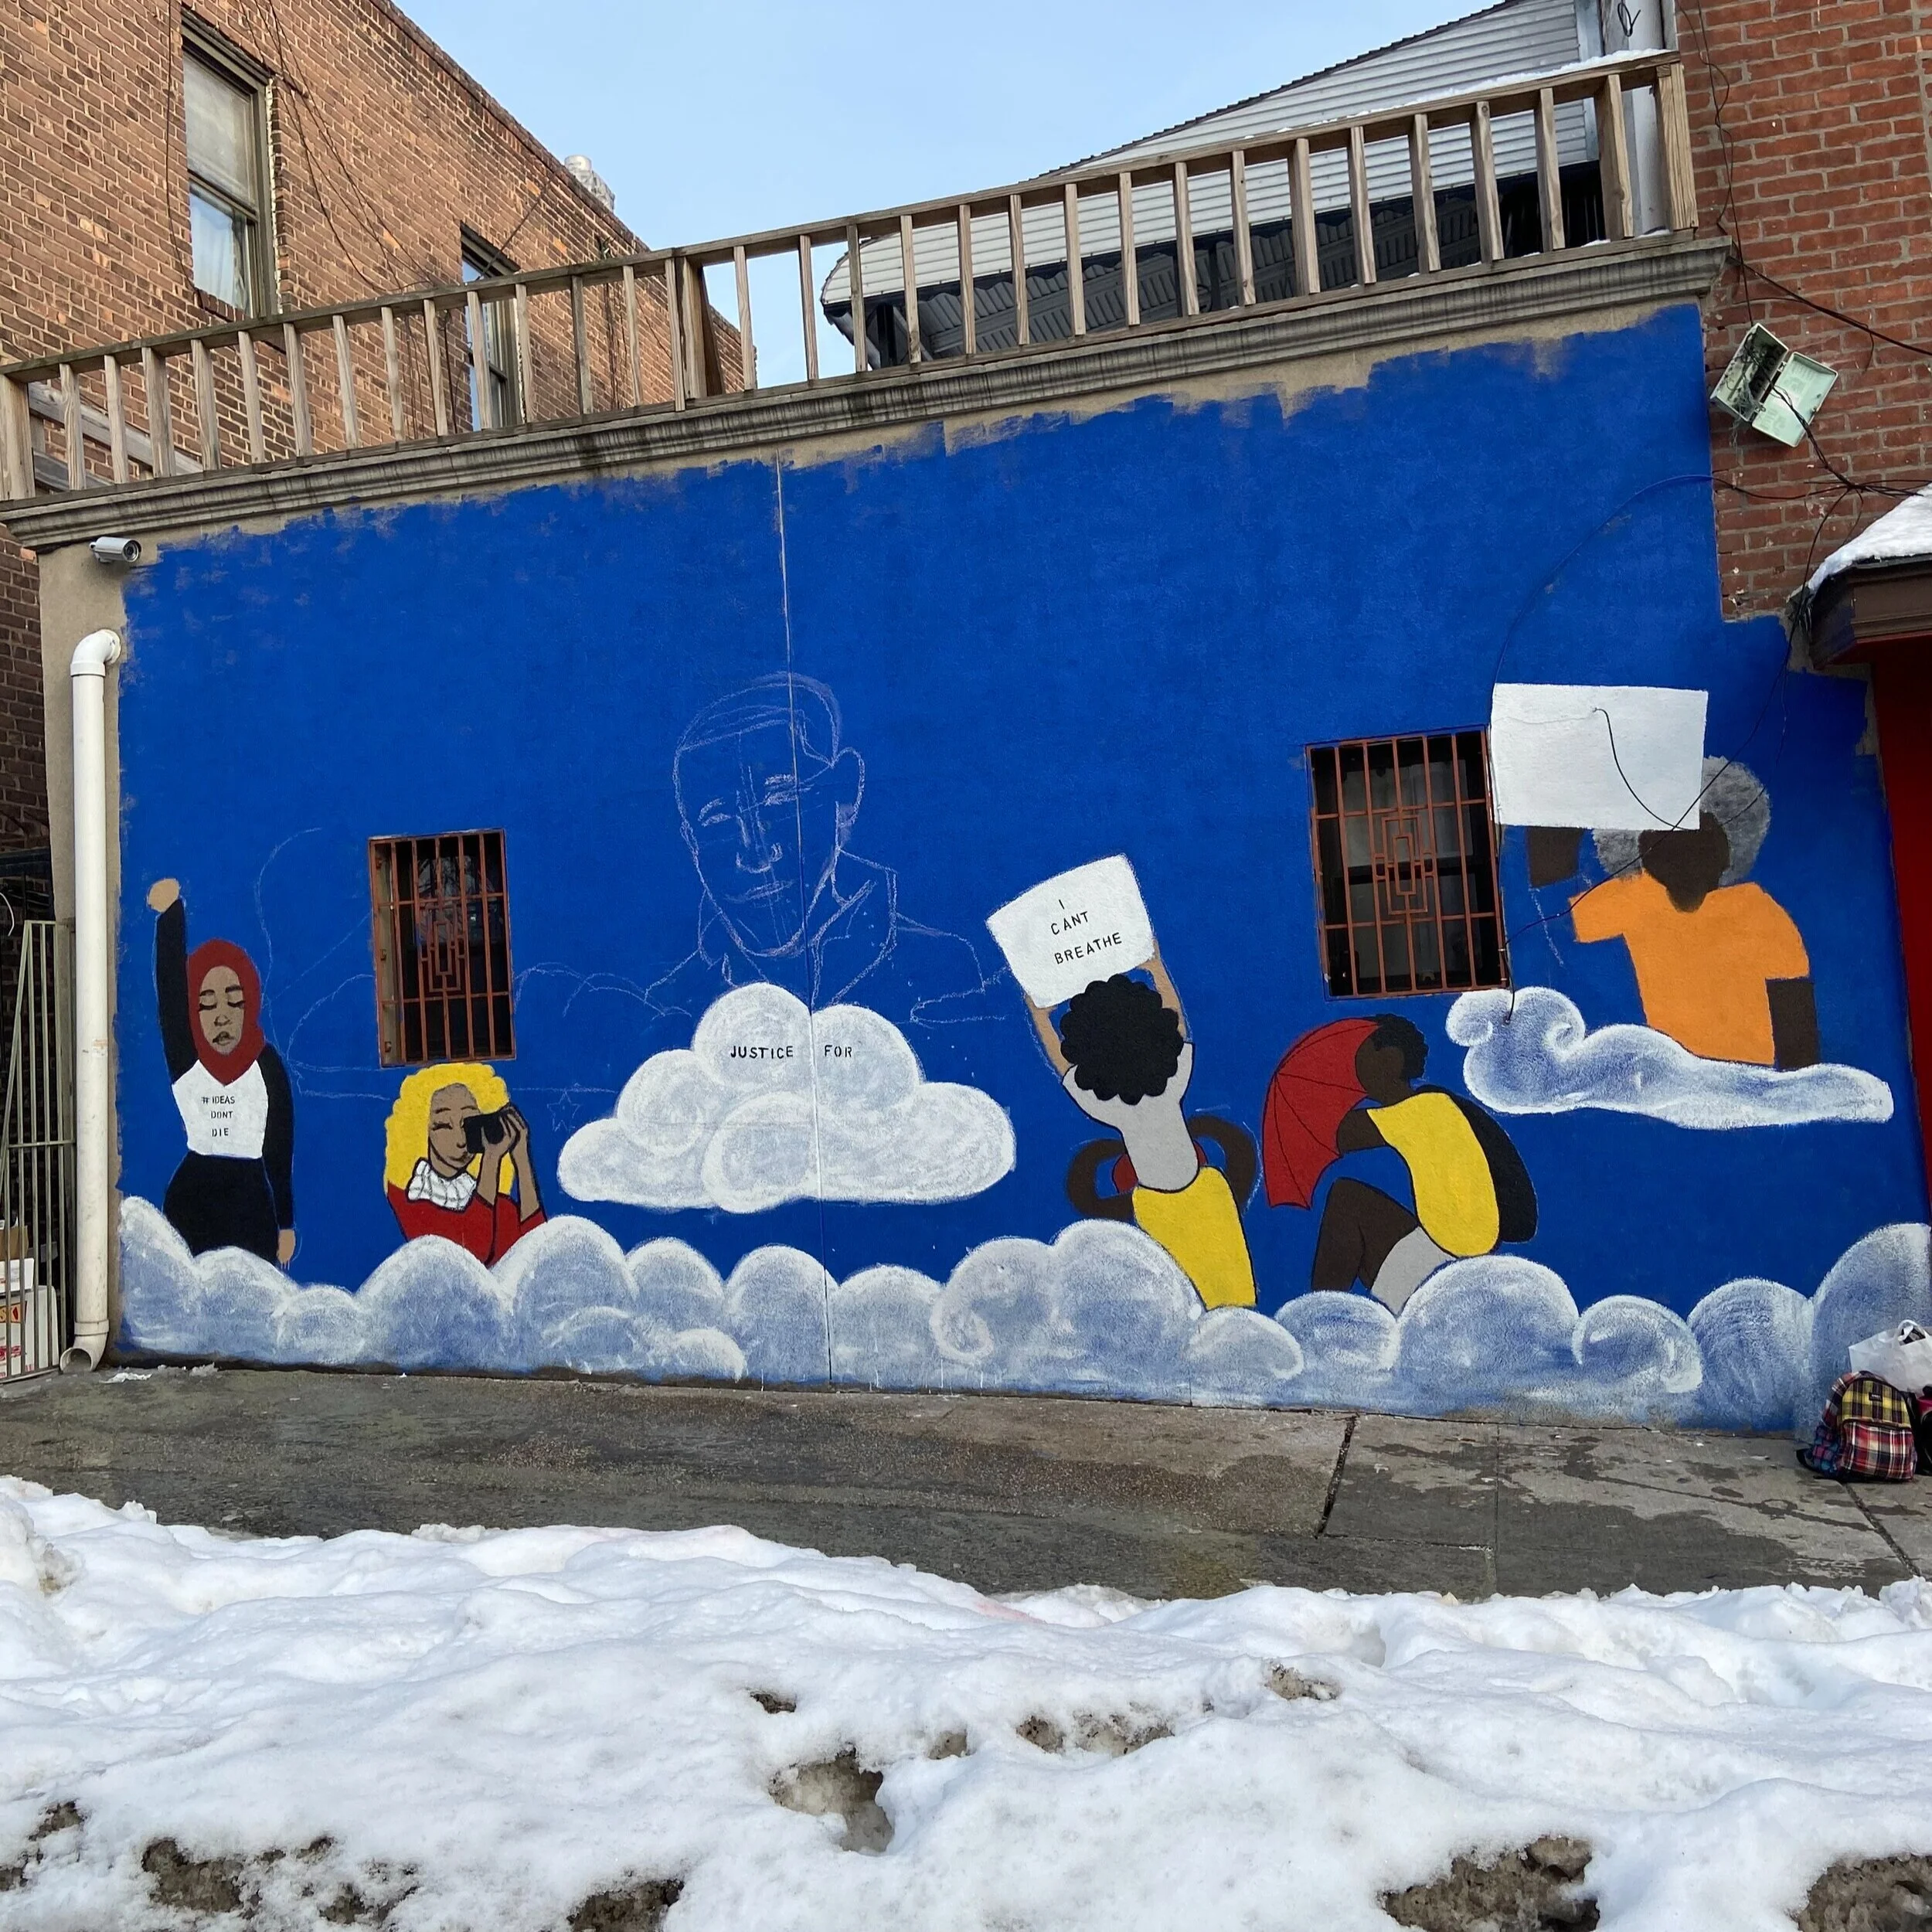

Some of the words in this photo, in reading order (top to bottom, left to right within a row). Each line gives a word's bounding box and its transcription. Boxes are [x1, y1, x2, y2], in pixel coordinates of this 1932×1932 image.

[1058, 899, 1065, 910] I
[1050, 911, 1088, 935] CANT
[1054, 932, 1122, 964] BREATHE
[730, 1046, 794, 1059] JUSTICE
[824, 1045, 852, 1058] FOR
[210, 1111, 233, 1119] DONT
[212, 1128, 229, 1137] DIE
